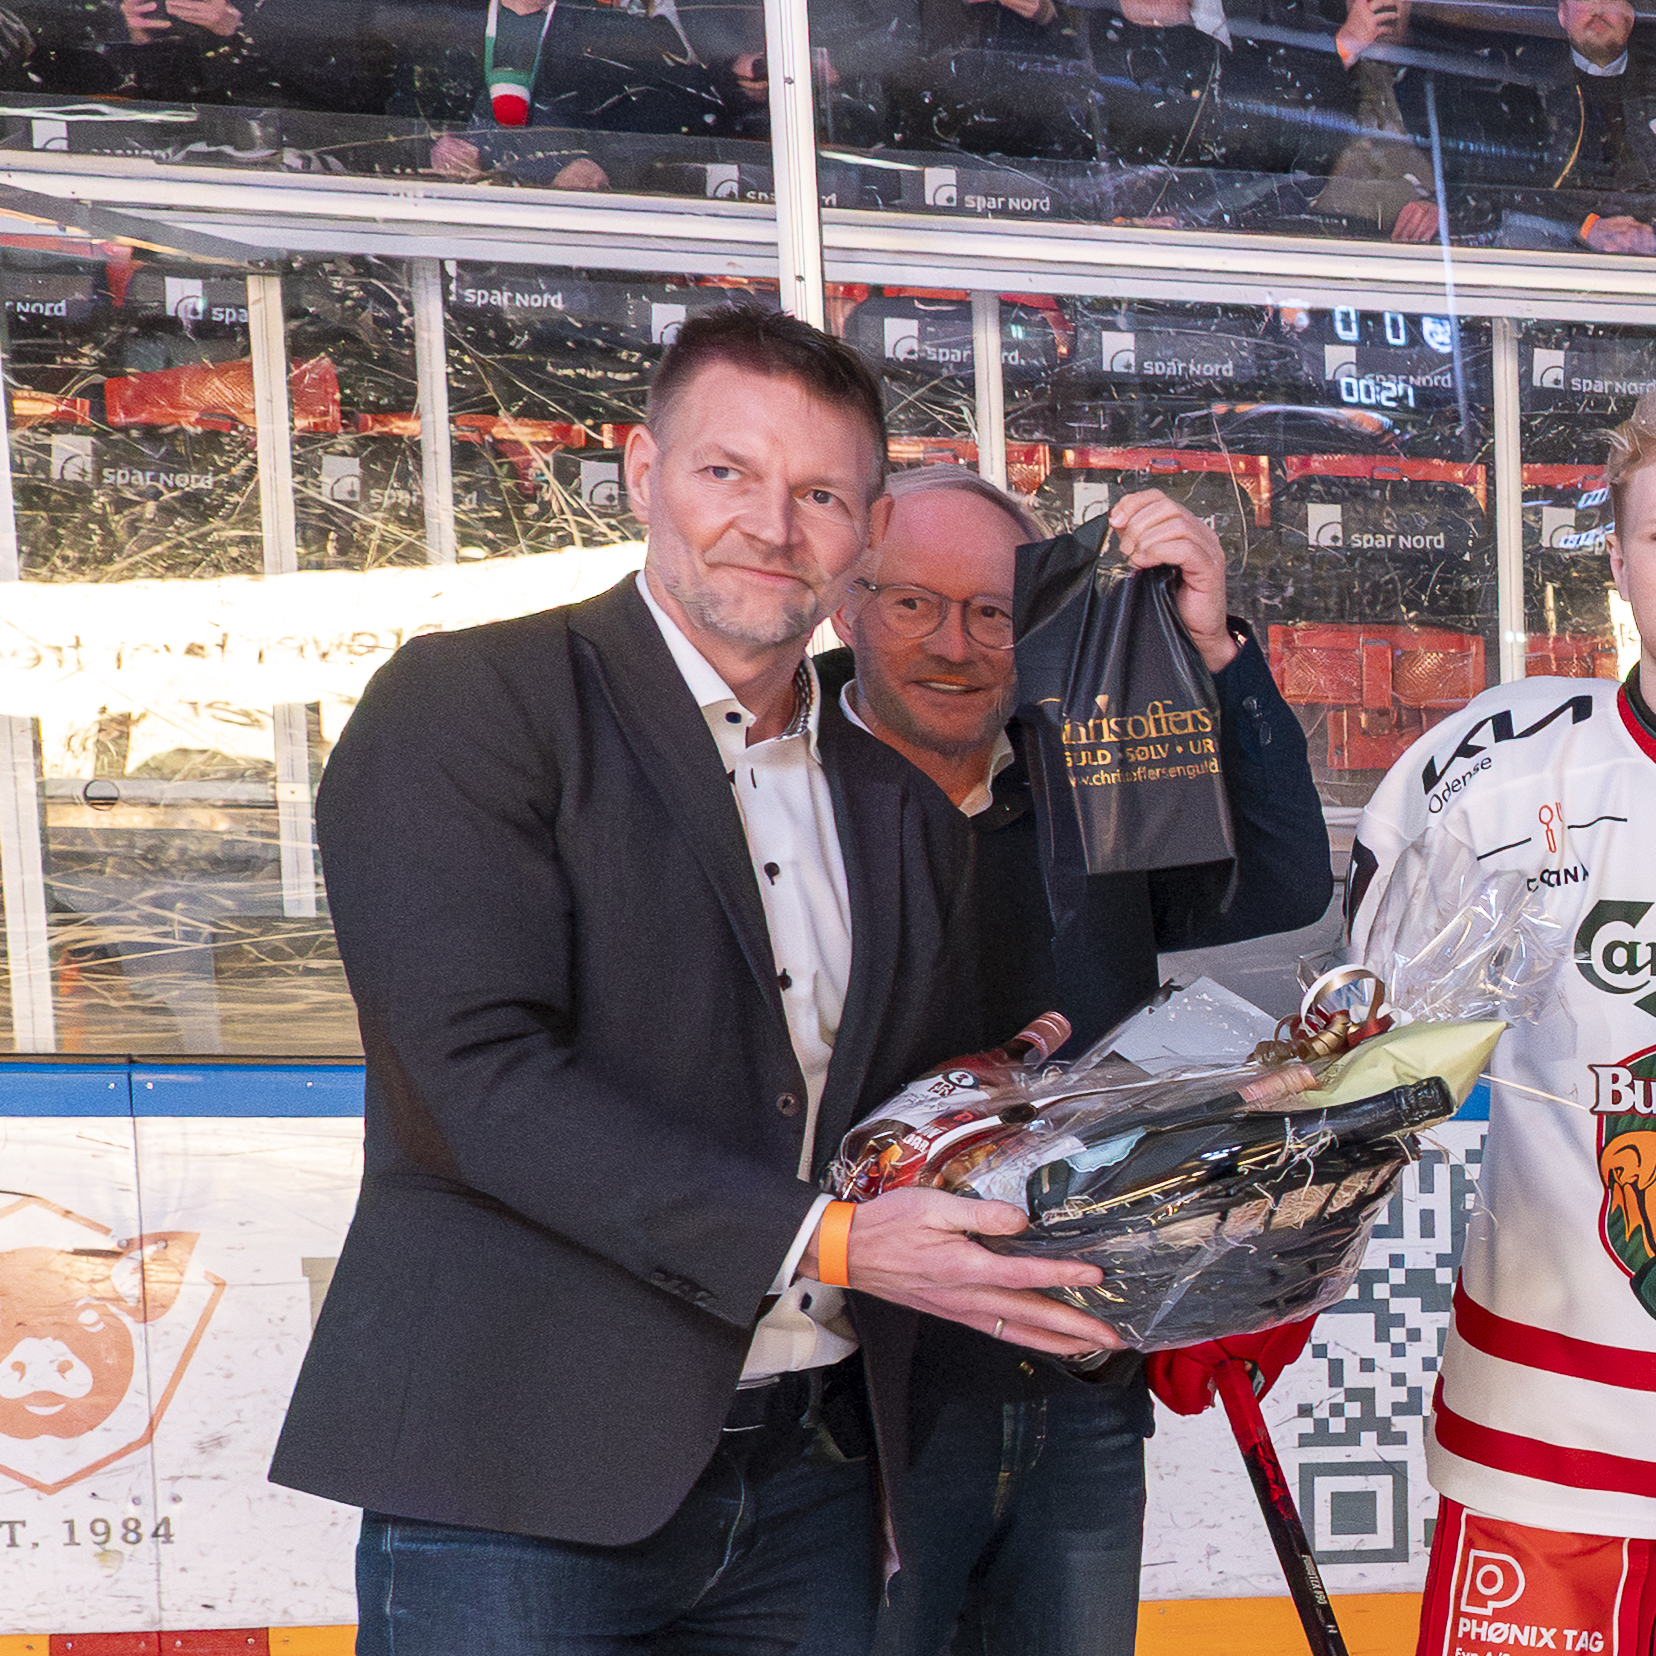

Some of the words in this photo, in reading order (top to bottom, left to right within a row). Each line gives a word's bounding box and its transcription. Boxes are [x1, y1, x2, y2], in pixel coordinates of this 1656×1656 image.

[1190, 737, 1217, 755] UR
[1428, 756, 1493, 814] Odense
[62, 1516, 175, 1550] 1984
[1458, 1616, 1558, 1651] PHØNIX
[1563, 1628, 1605, 1653] TAG
